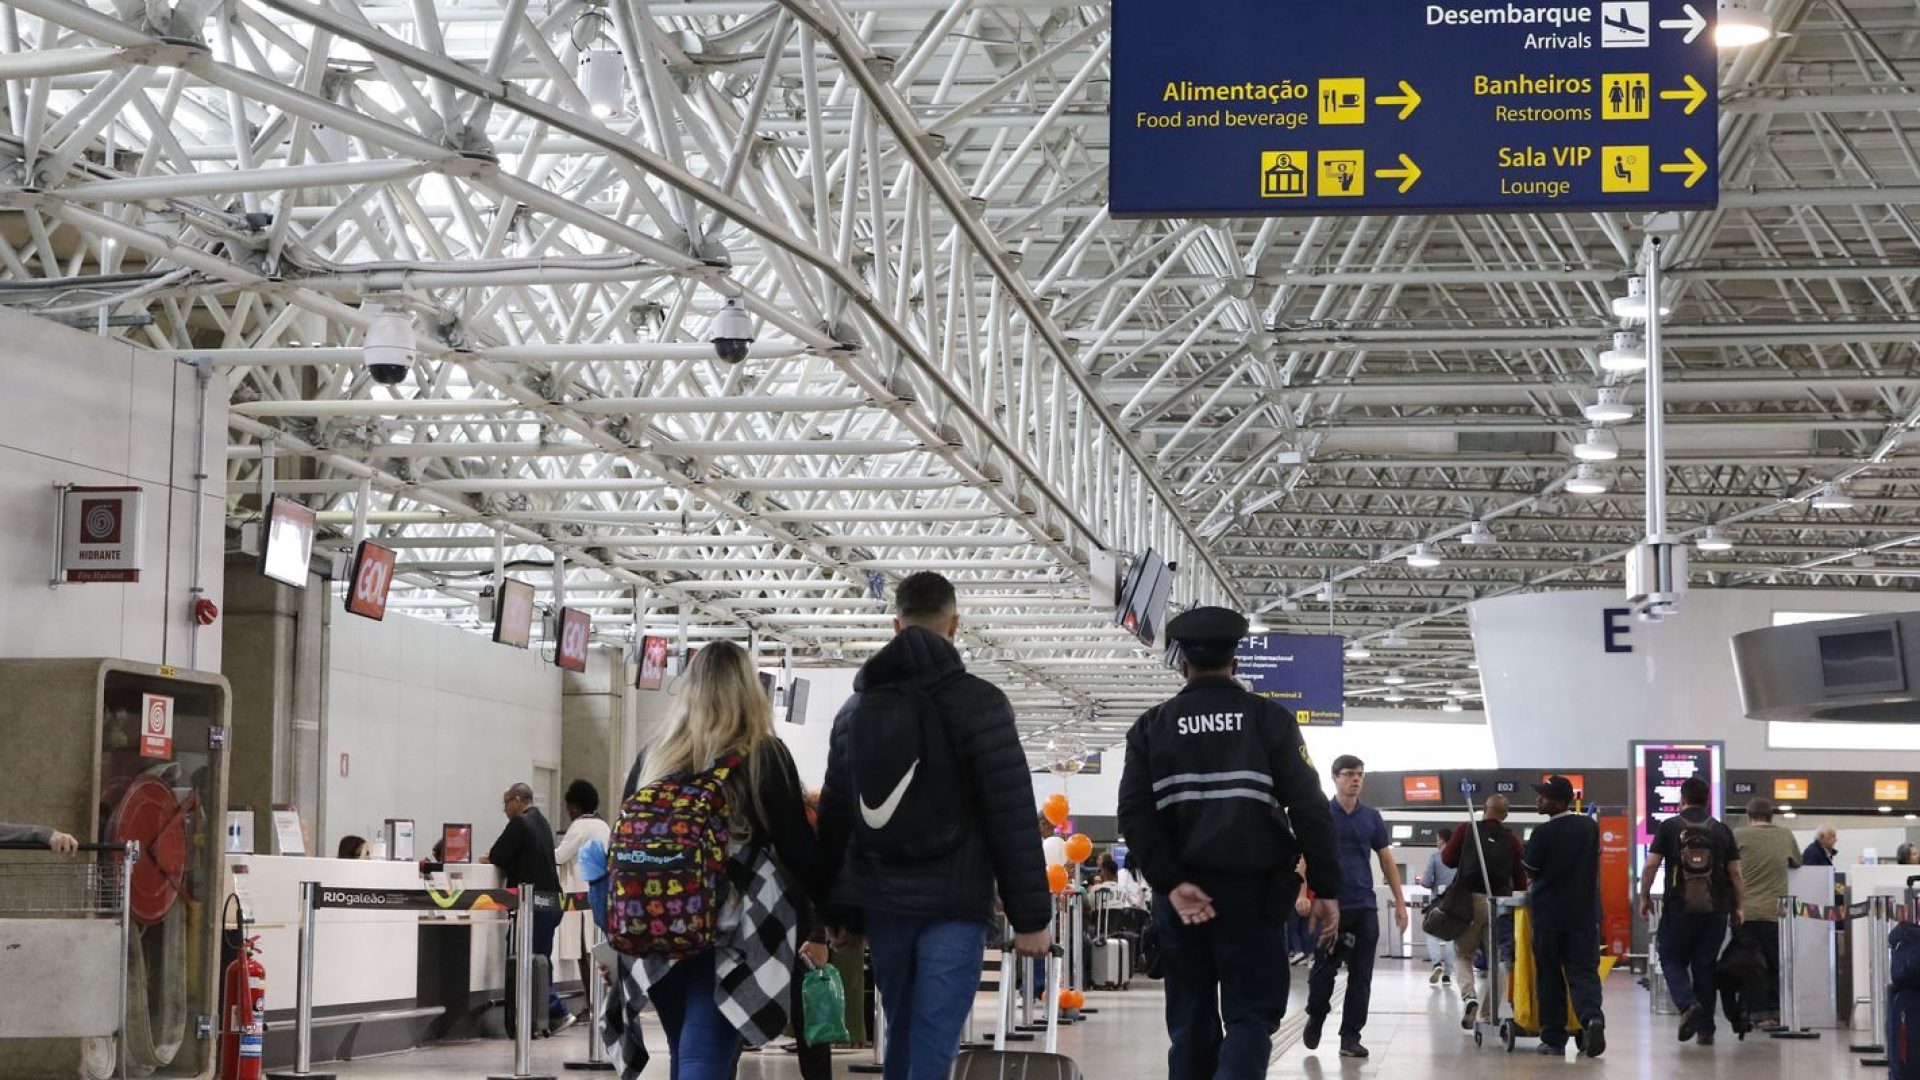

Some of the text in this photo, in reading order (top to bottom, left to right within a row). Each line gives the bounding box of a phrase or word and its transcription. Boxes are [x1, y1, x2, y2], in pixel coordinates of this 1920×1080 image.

[1426, 3, 1592, 28] Desembarque
[1524, 31, 1592, 49] Arrivals
[1163, 80, 1309, 105] Alimentação
[1474, 73, 1592, 95] Banheiros
[1136, 110, 1309, 130] Food and beverage
[1496, 105, 1592, 121] Restrooms
[1498, 146, 1592, 168] Sala VIP
[1501, 178, 1570, 198] Lounge
[79, 550, 121, 561] HIDRANTE
[358, 558, 387, 606] GOL
[1603, 608, 1633, 653] E
[1177, 712, 1244, 735] SUNSET
[1497, 783, 1515, 792] E02
